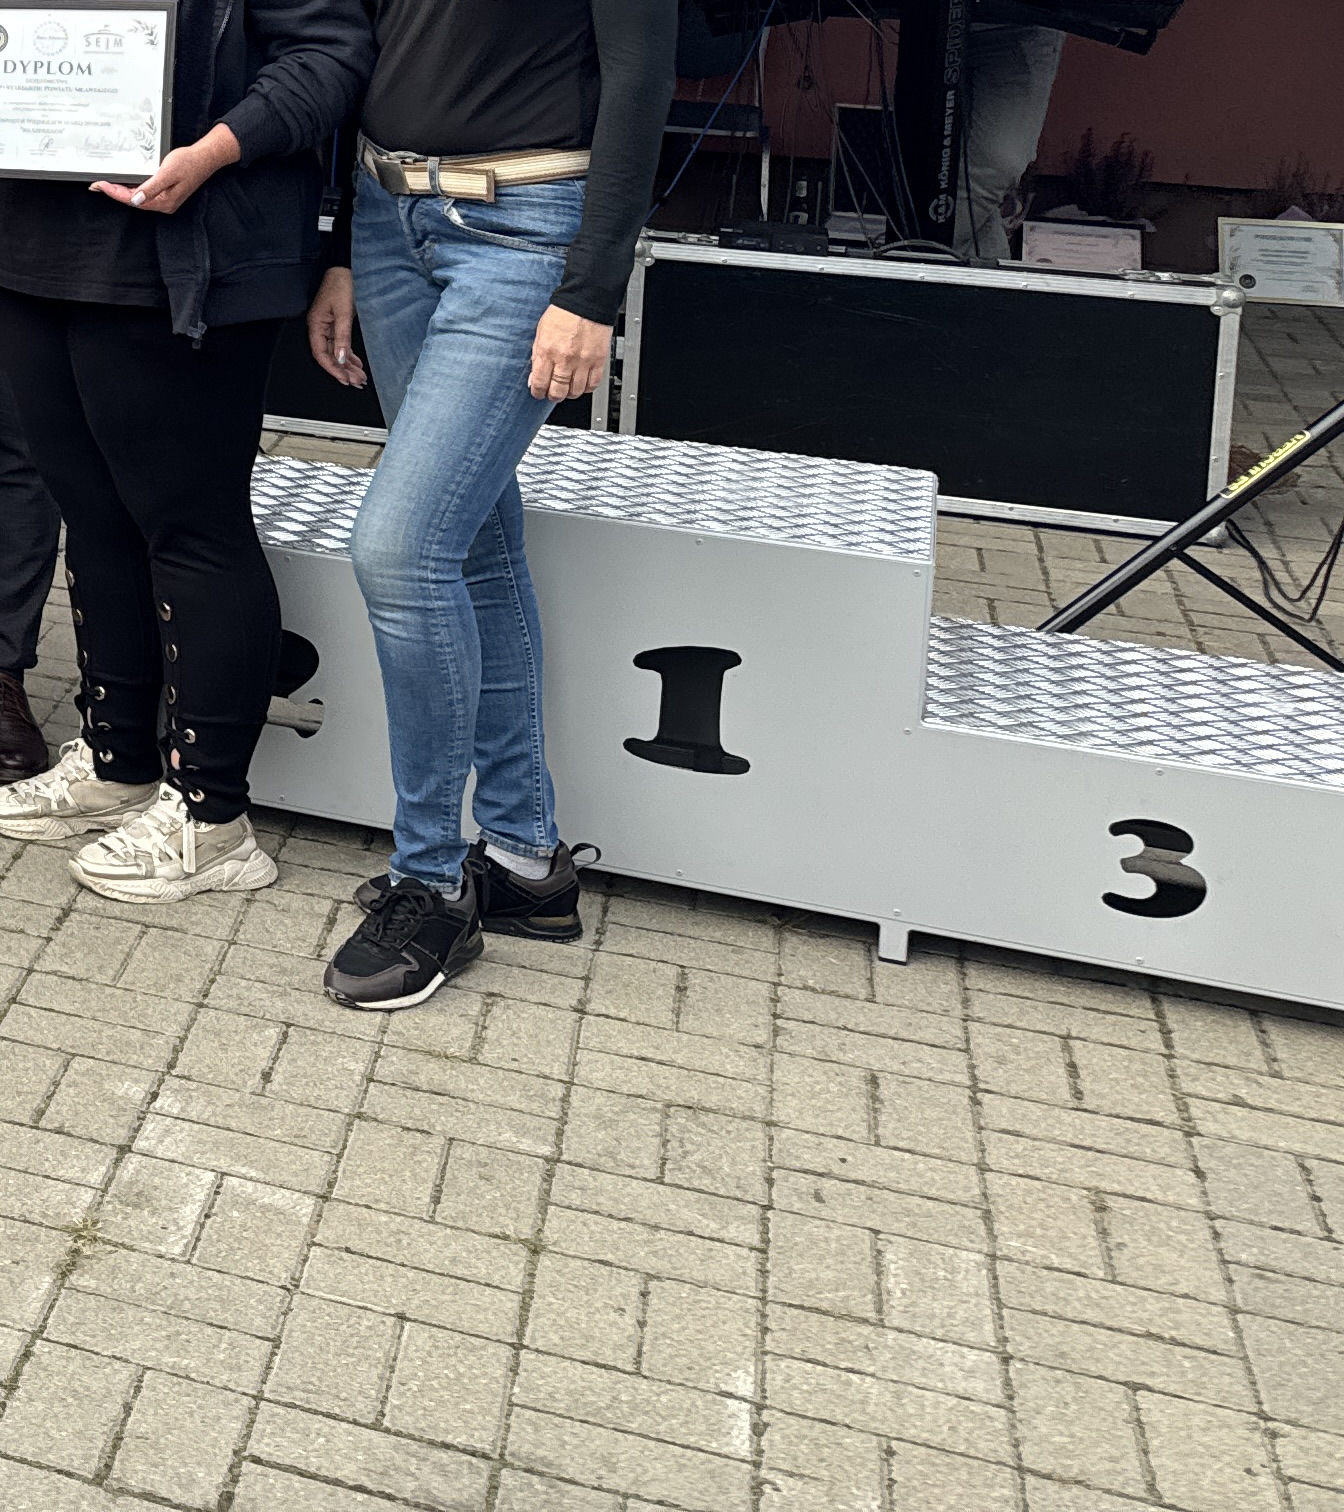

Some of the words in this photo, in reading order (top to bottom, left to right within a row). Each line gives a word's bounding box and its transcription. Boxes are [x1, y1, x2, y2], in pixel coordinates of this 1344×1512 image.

[3, 59, 93, 76] DYPLOM
[943, 90, 957, 135] MEYER
[939, 148, 952, 189] KÖNIG
[622, 646, 751, 775] 1
[1101, 818, 1207, 918] 3
